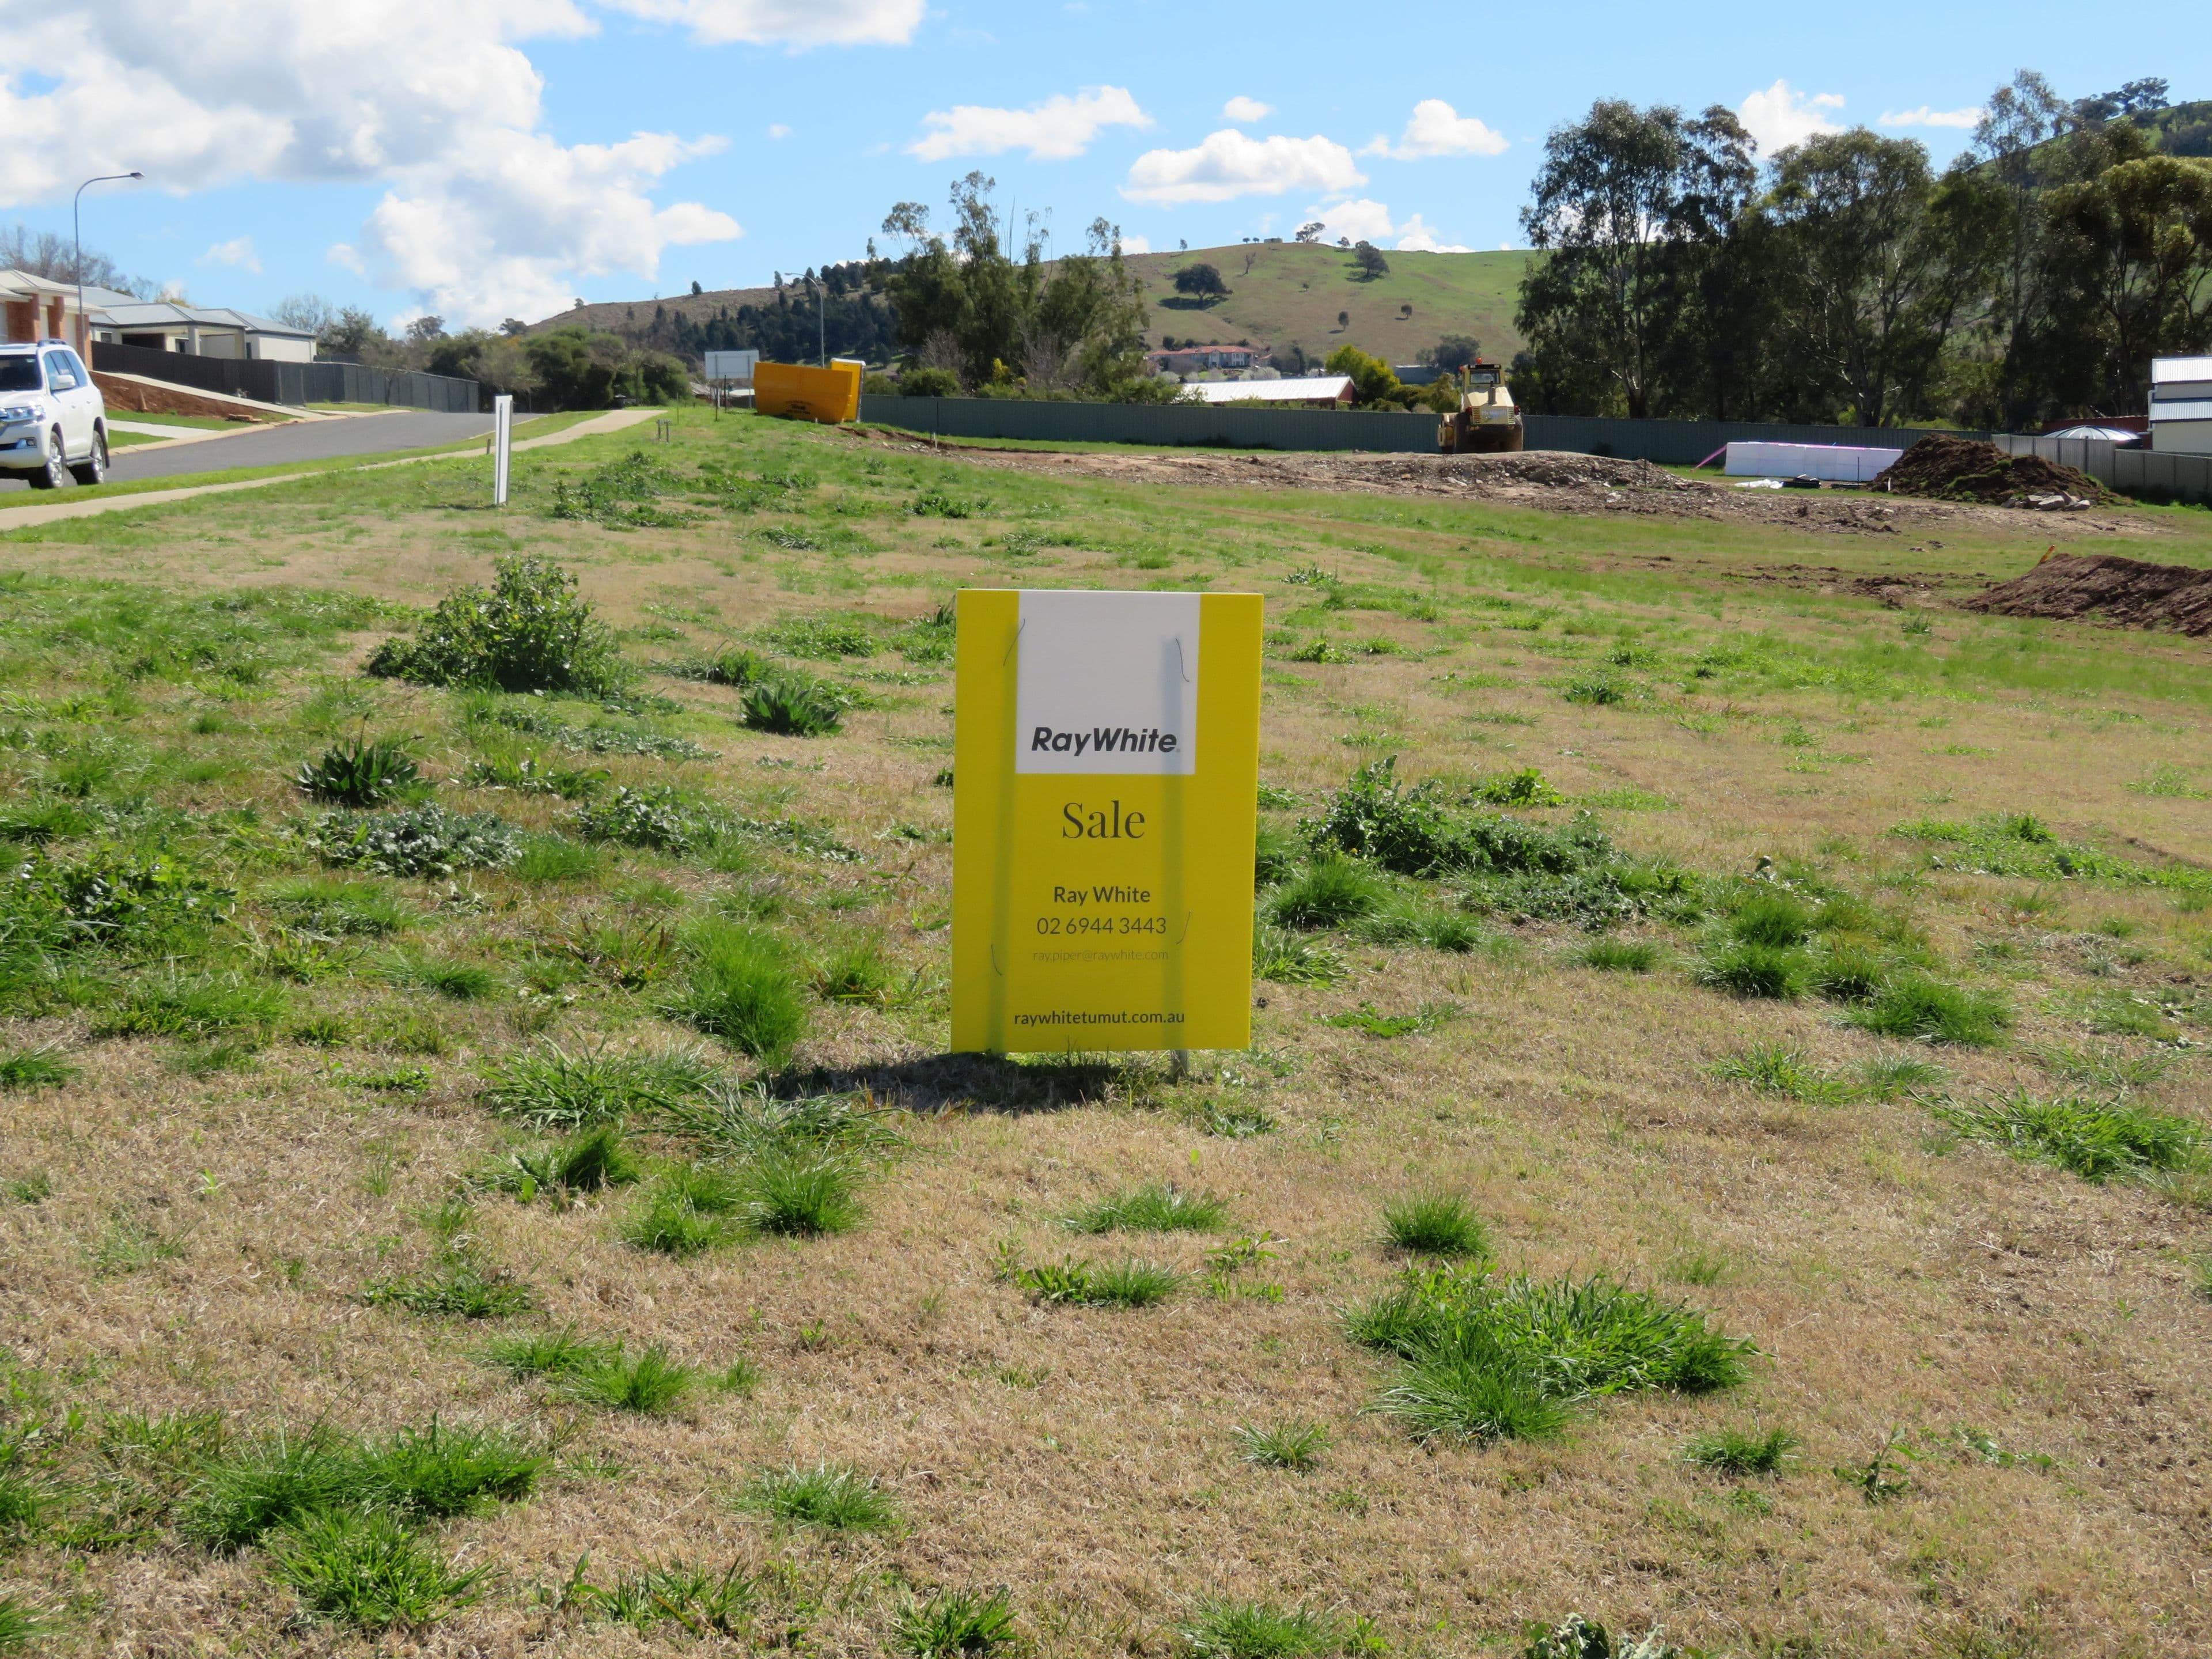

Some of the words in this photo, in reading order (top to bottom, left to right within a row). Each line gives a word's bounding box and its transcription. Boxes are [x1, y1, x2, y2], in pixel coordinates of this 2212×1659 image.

[1062, 800, 1145, 839] Sale
[1054, 886, 1088, 906] Ray
[1093, 886, 1151, 903] White
[1037, 918, 1060, 934] 02
[1066, 918, 1113, 934] 6944
[1119, 918, 1166, 934] 3443
[1033, 950, 1169, 963] ray.piper@raywhite.com
[1014, 1010, 1185, 1027] raywhitetumut.com.au
